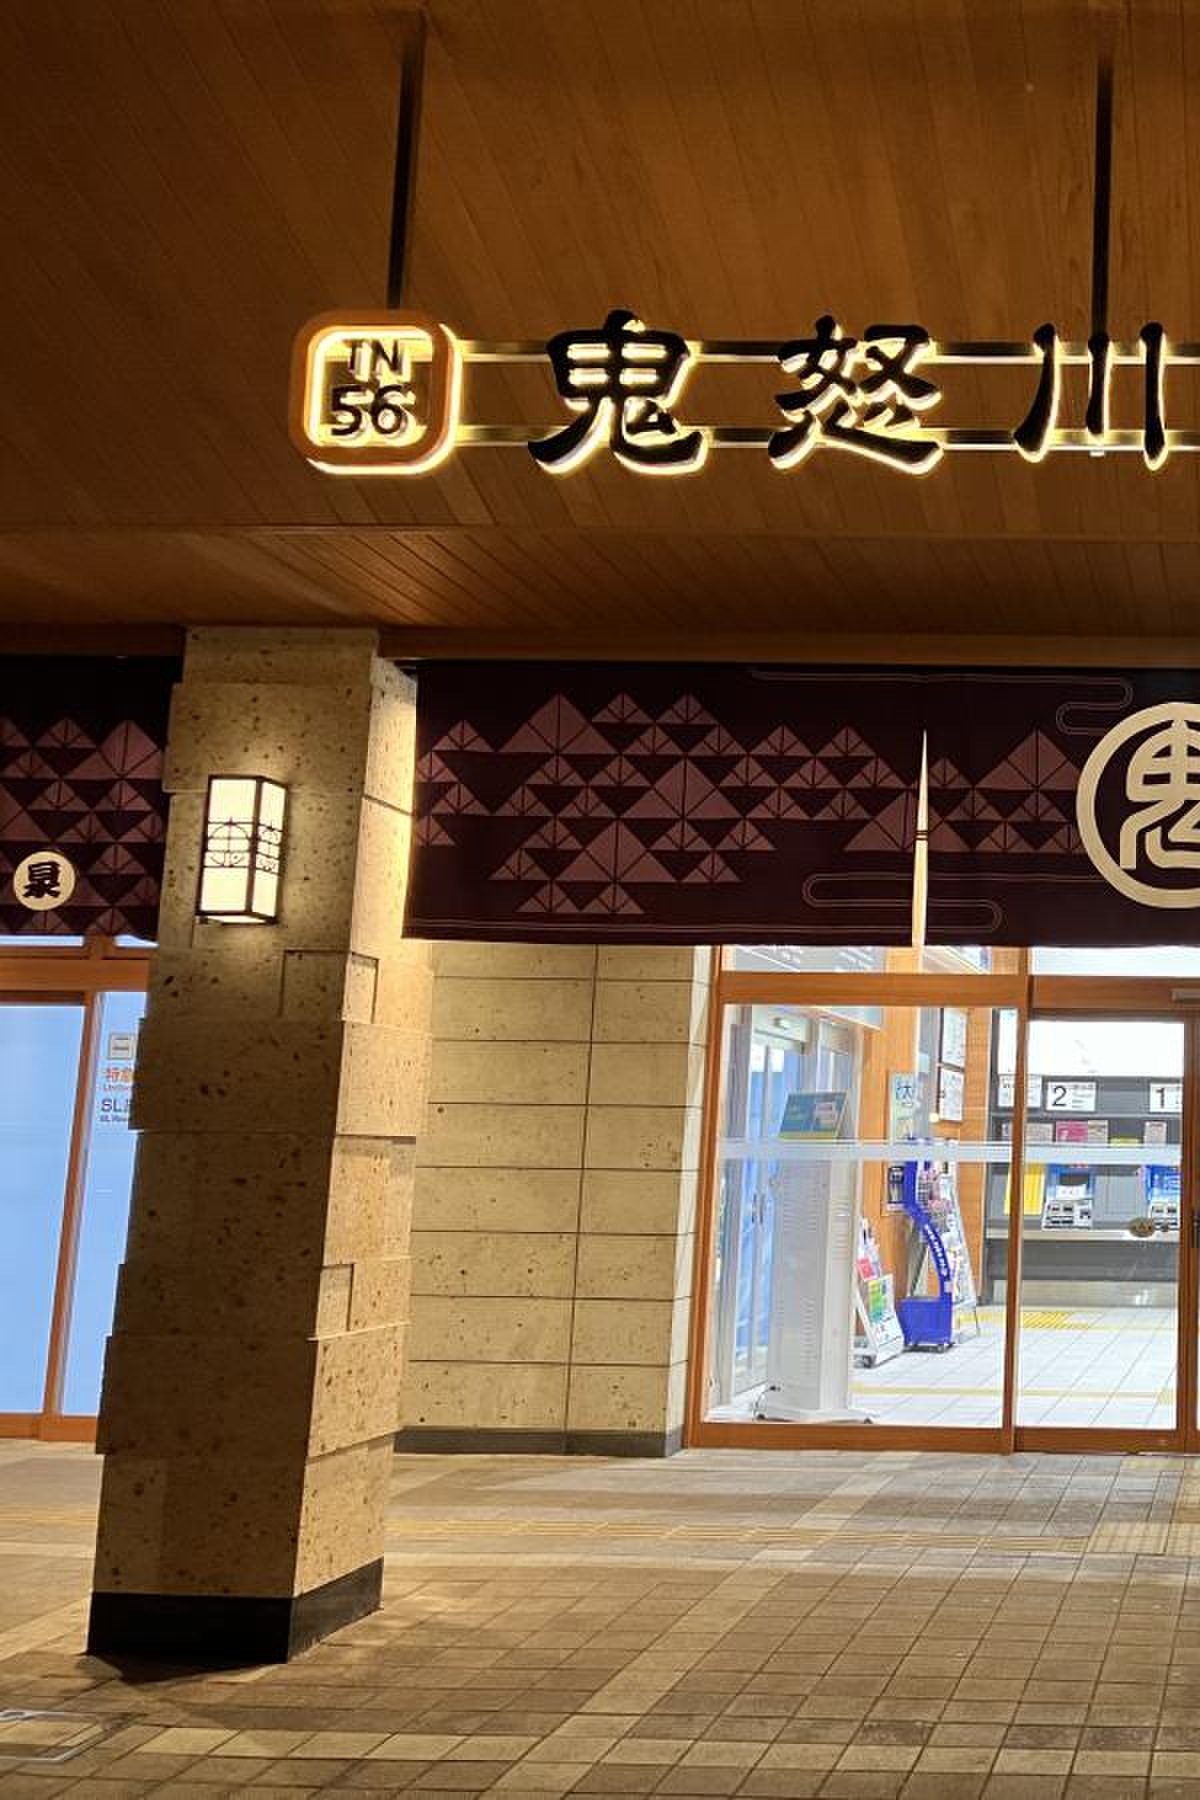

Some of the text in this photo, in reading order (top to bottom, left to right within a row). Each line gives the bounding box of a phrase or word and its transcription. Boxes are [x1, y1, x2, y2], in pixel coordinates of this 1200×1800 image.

[331, 383, 405, 437] 56
[1052, 1085, 1068, 1107] 2
[1156, 1086, 1166, 1109] 1
